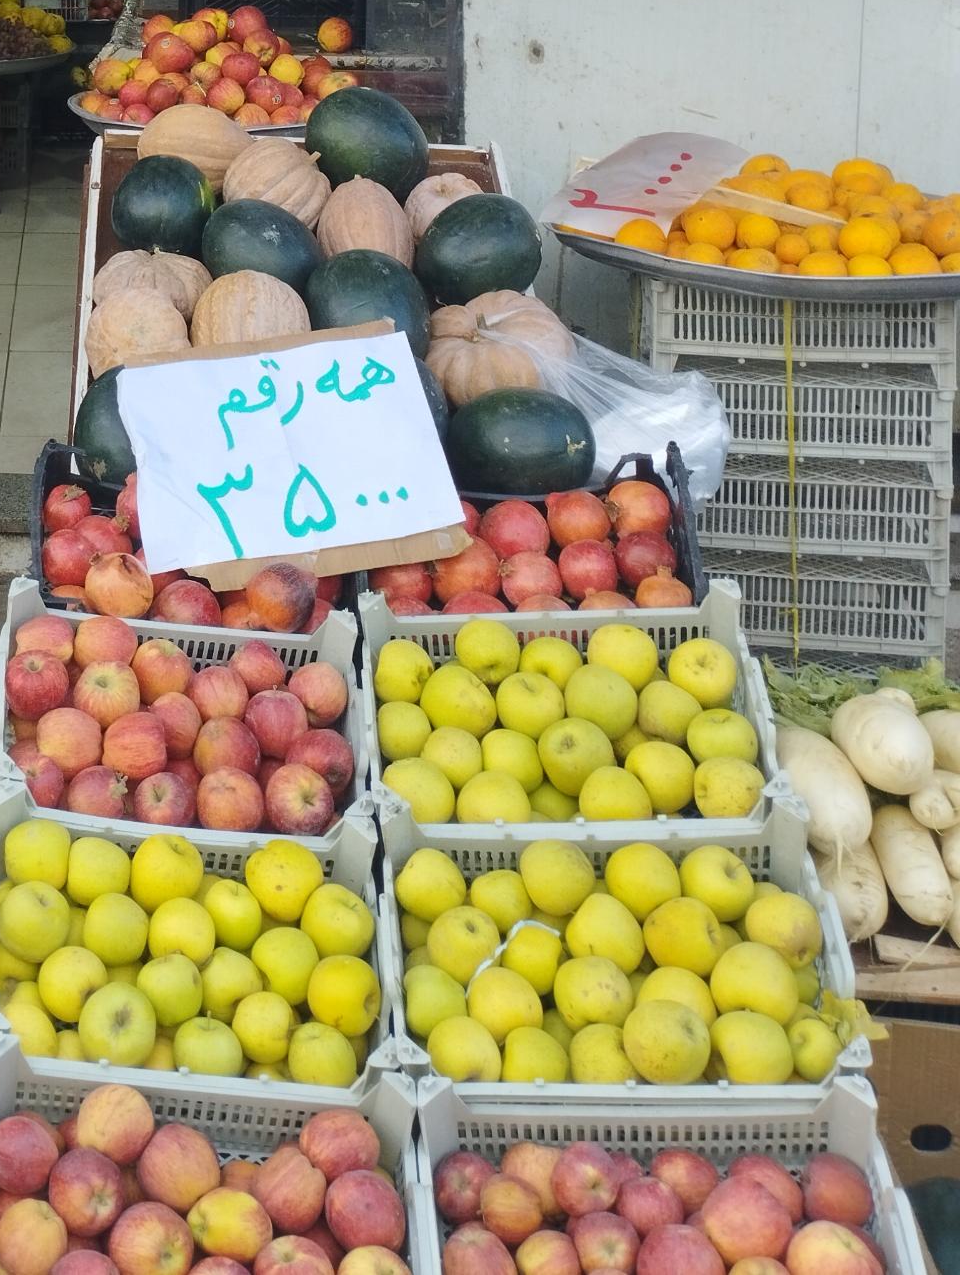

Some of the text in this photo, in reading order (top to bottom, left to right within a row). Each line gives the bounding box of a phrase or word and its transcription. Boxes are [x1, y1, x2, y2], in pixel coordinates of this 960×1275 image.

[217, 356, 397, 451] همه رقم
[196, 462, 410, 559] ۳۵۰۰۰
